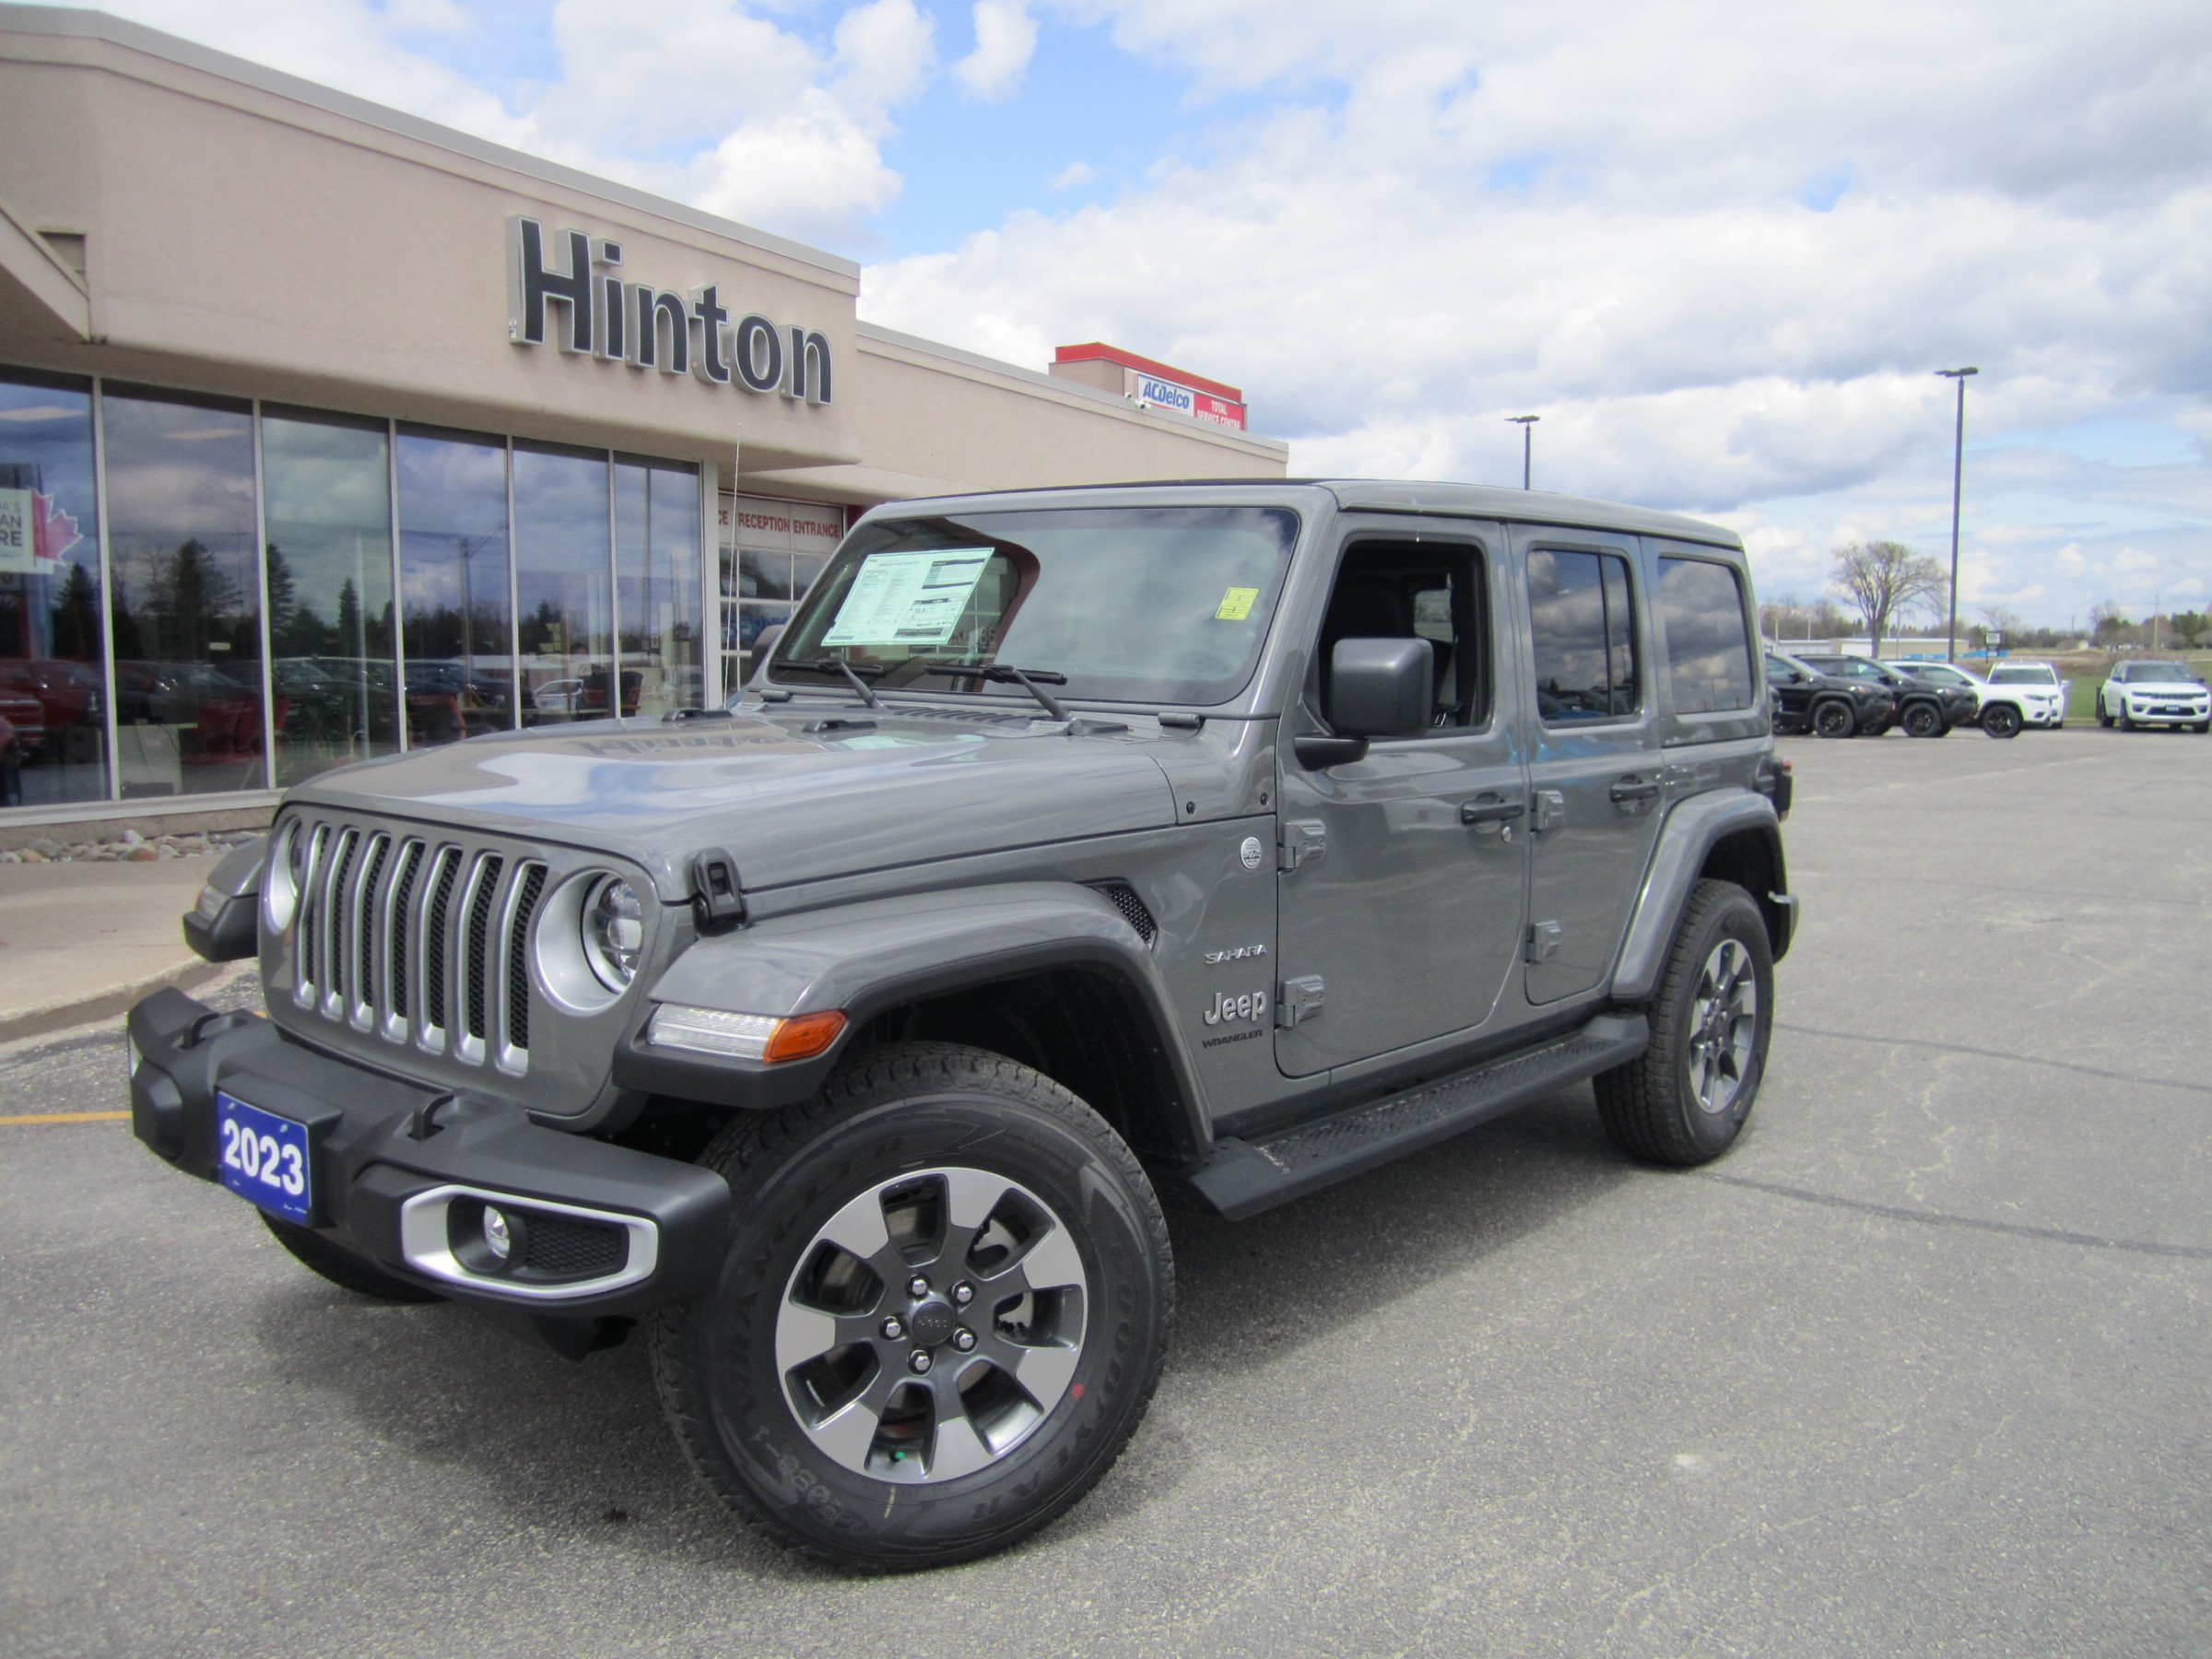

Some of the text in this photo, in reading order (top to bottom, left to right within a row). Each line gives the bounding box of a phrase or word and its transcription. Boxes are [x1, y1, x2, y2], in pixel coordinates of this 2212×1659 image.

[510, 214, 832, 406] Hinton
[1143, 381, 1189, 409] ACDelco
[1210, 399, 1228, 415] TOTAL
[1197, 409, 1241, 429] SERVICE CENTRE
[738, 512, 790, 533] RECEPTION
[794, 519, 840, 538] ENTRANCE
[1205, 944, 1267, 964] SAHARA
[1204, 991, 1267, 1025] Jeep
[1202, 1030, 1264, 1049] WRANGLER
[224, 1118, 304, 1195] 2023
[971, 1242, 1136, 1521] GOODYEAR
